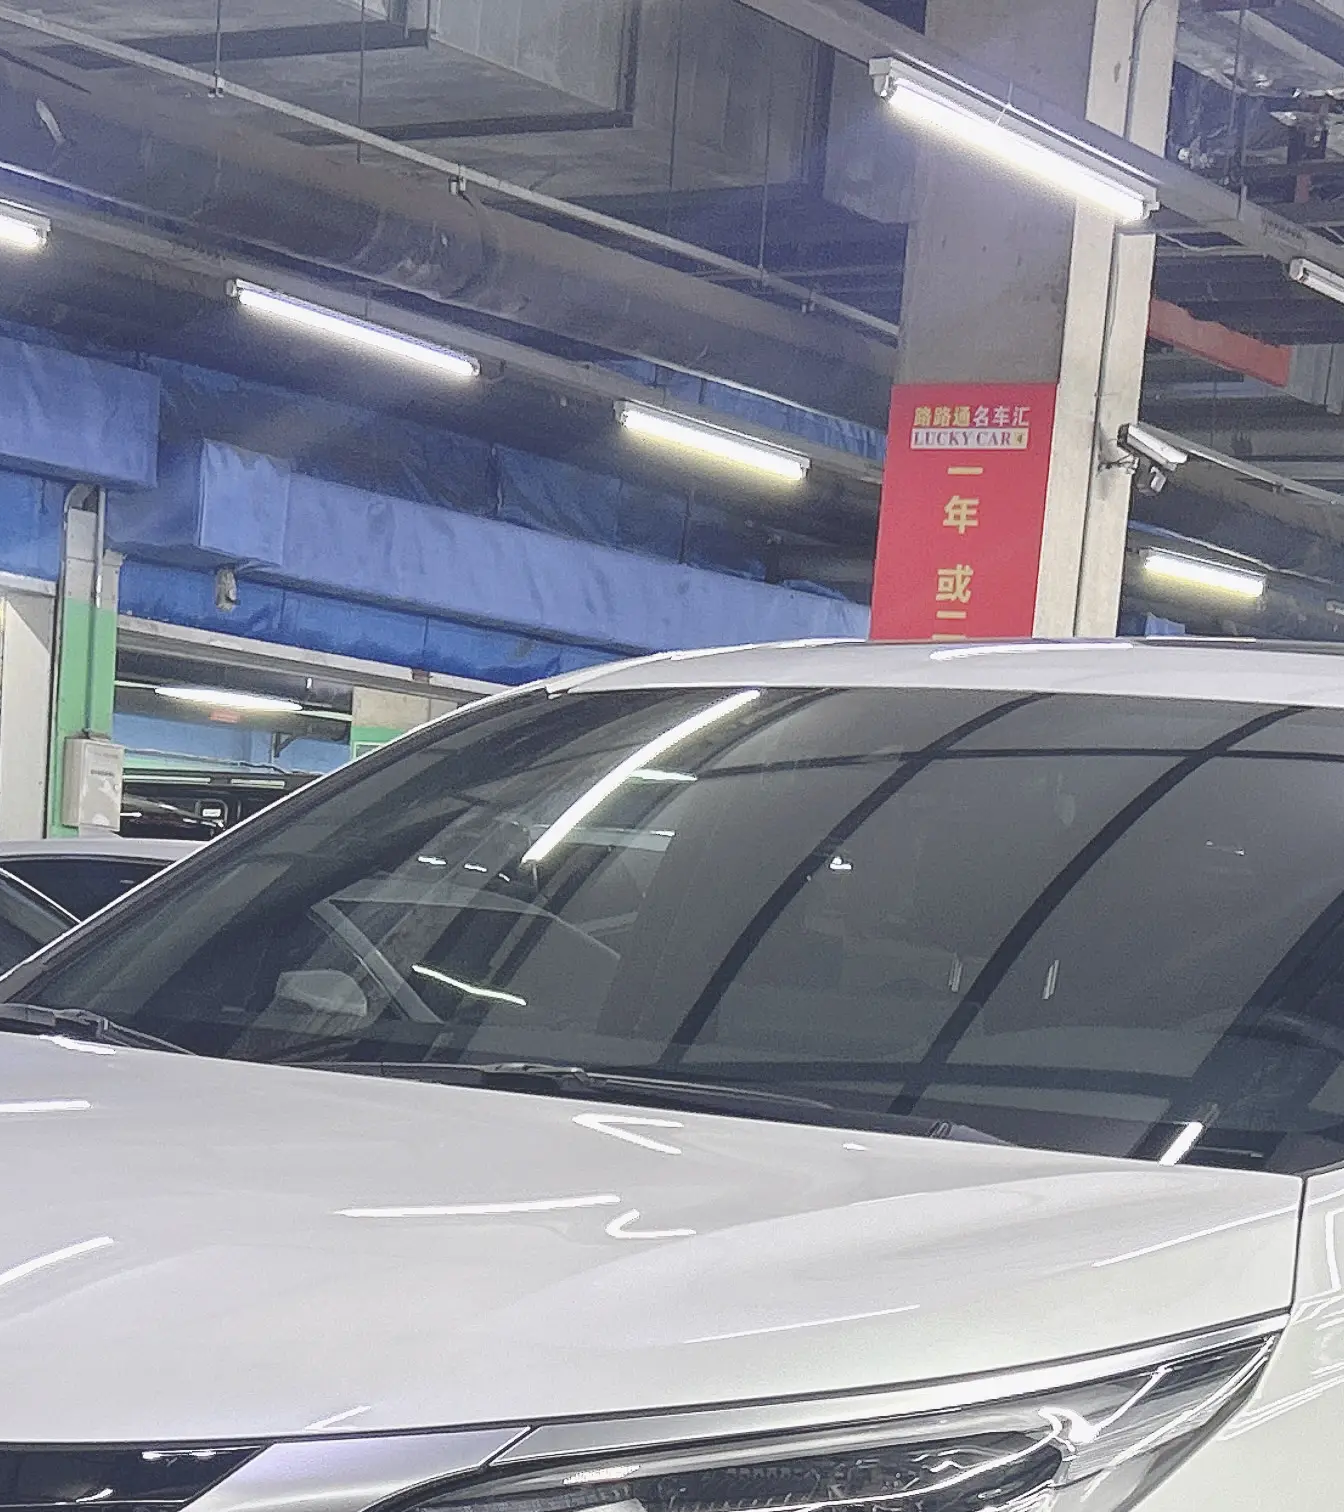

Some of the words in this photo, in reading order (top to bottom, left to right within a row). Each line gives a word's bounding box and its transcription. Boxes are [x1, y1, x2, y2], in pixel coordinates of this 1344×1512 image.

[913, 405, 1031, 427] 路路通名车汇
[913, 430, 973, 447] LUCKY
[976, 430, 1012, 447] CAR
